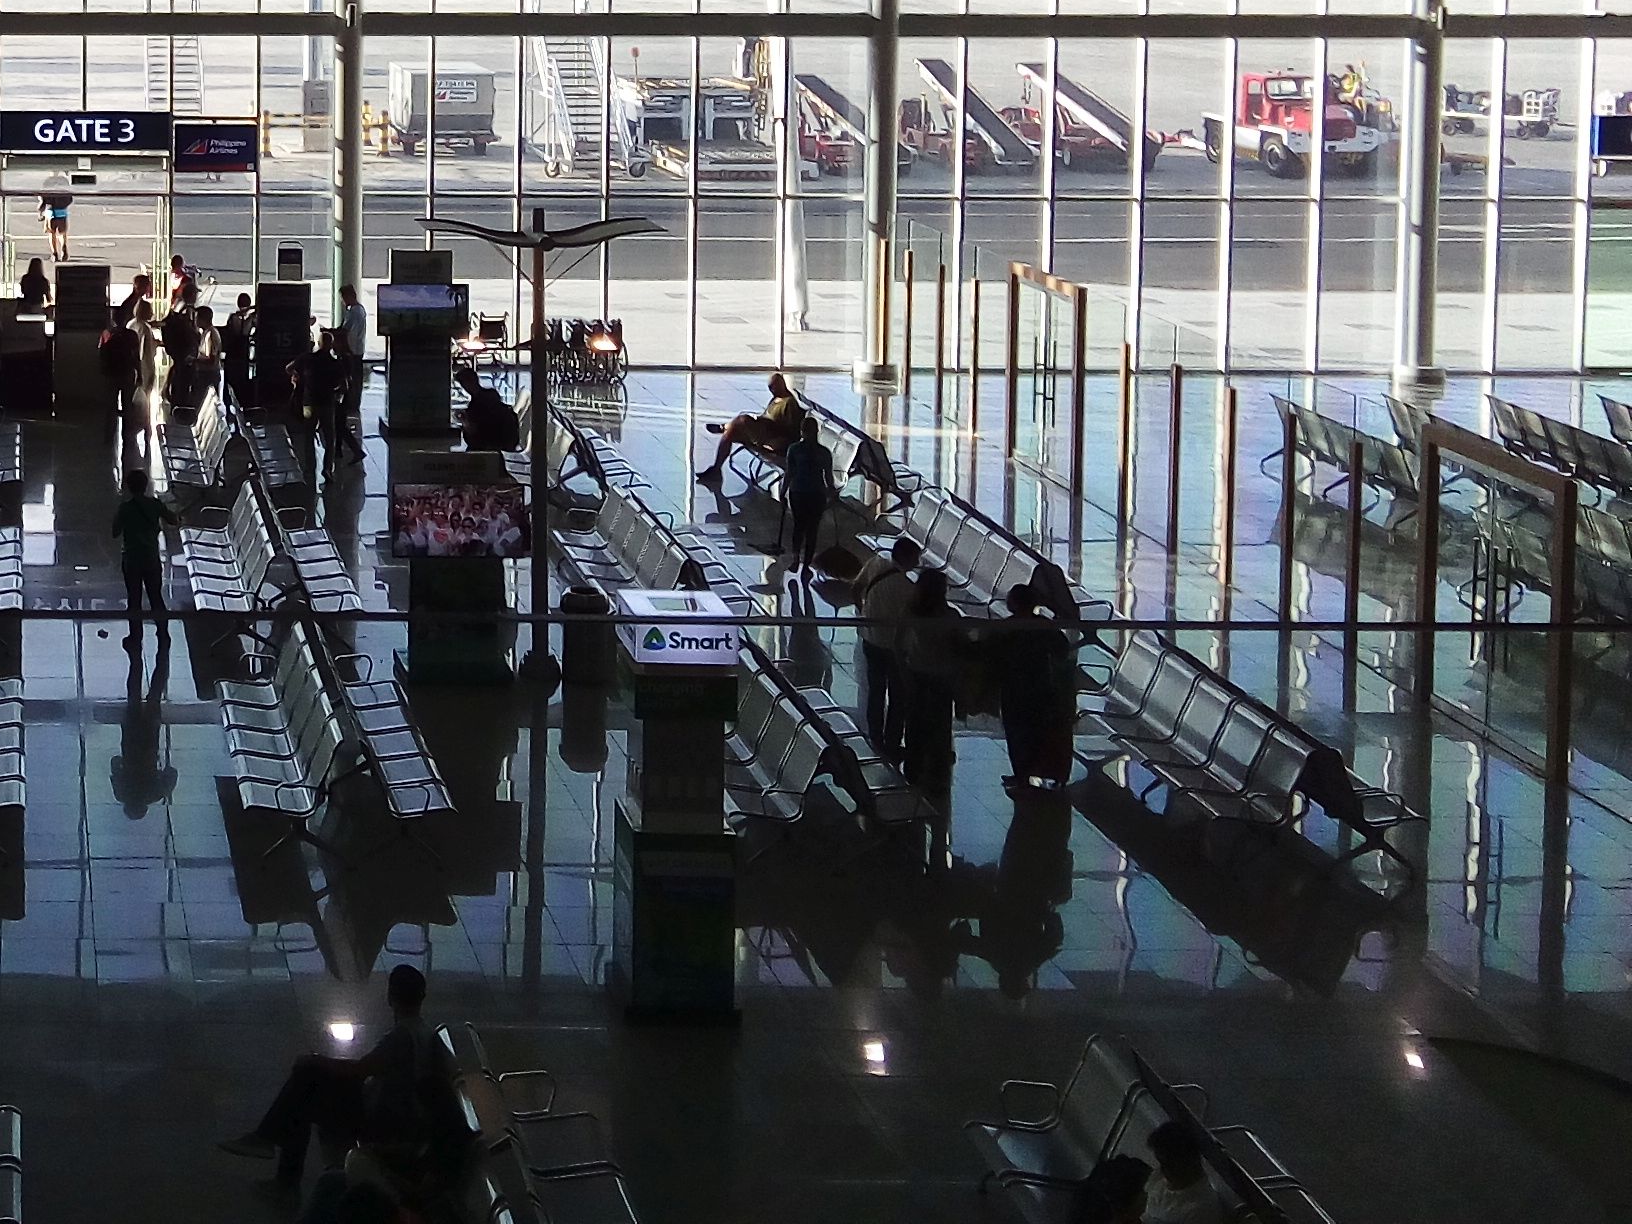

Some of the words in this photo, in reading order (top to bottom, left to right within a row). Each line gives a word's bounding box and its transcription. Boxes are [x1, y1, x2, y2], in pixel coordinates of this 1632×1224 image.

[33, 119, 110, 143] GATE
[117, 119, 135, 143] 3
[209, 138, 247, 149] Philippine
[209, 146, 239, 155] Airlines
[274, 332, 292, 347] 15
[668, 631, 734, 651] Smart
